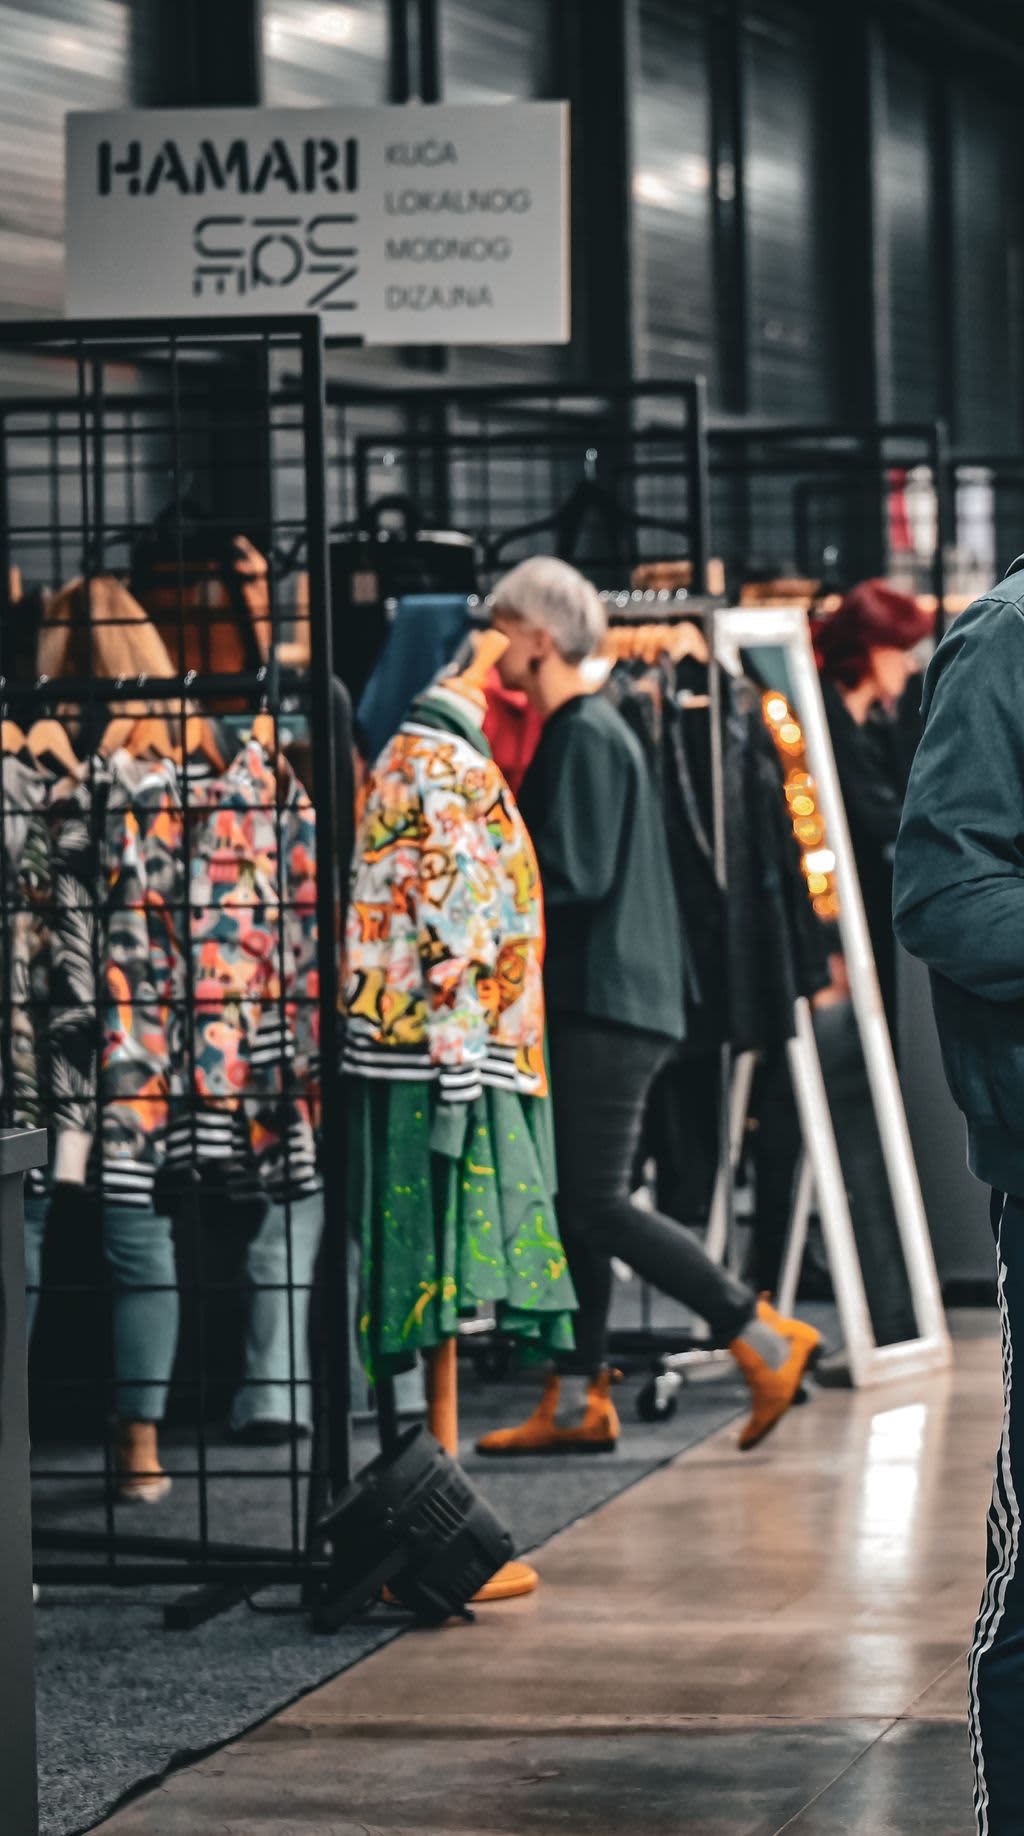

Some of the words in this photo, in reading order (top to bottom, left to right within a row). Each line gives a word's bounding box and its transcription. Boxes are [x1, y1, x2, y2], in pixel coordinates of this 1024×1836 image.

[98, 137, 359, 196] HAMARI
[385, 190, 531, 216] LOKALNOG
[385, 238, 511, 263] MODNOG
[385, 286, 495, 311] DIZAJNA
